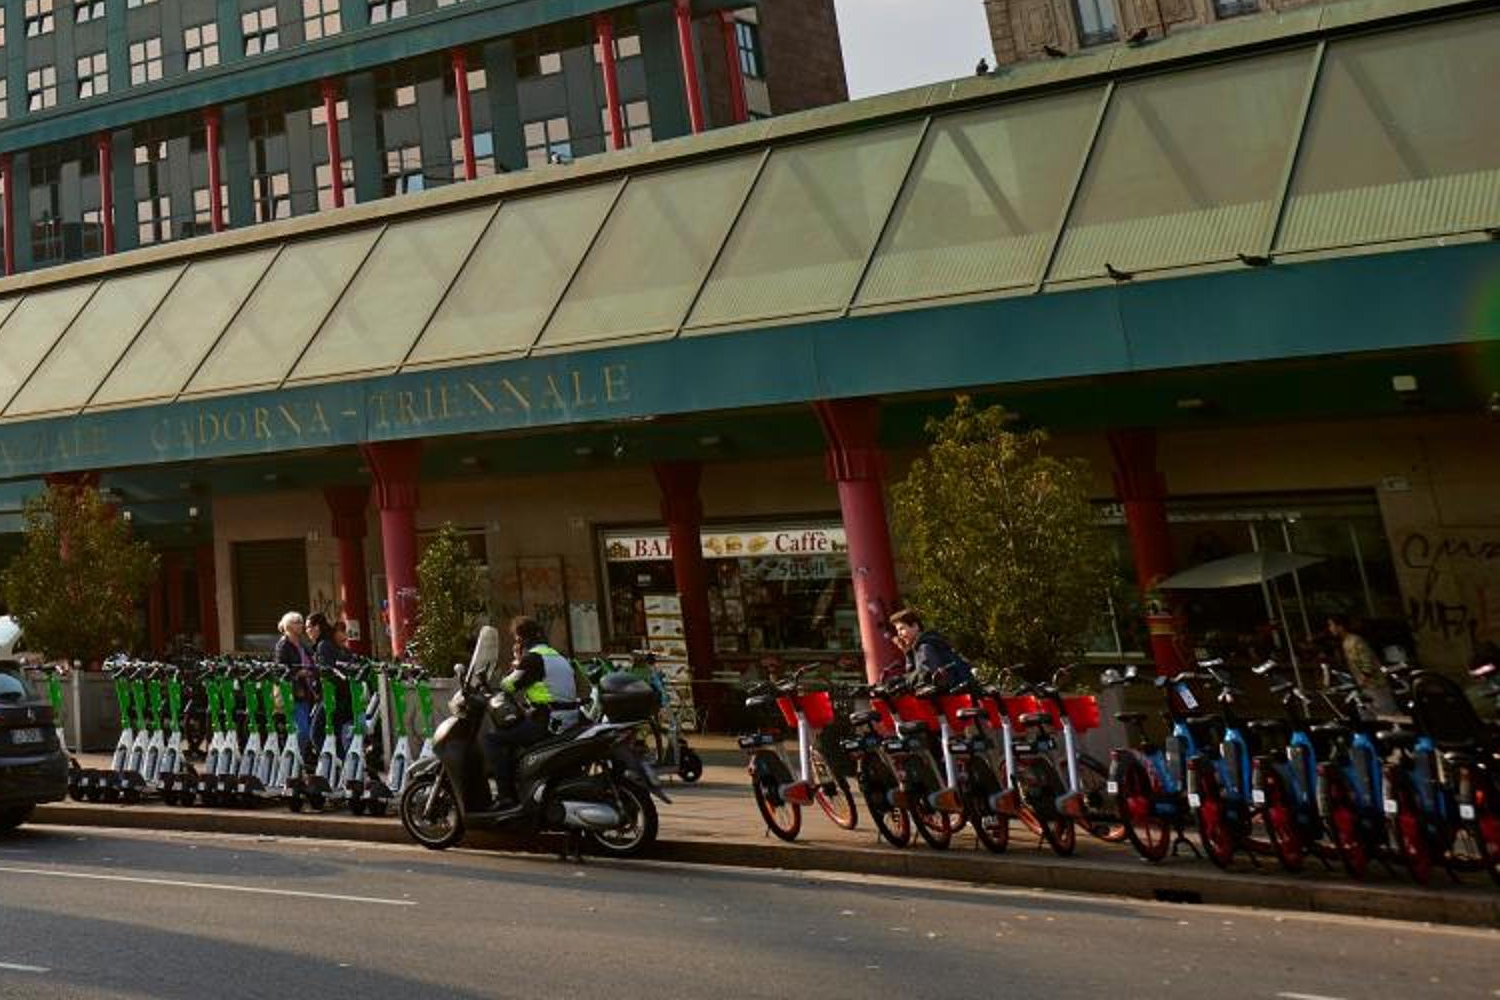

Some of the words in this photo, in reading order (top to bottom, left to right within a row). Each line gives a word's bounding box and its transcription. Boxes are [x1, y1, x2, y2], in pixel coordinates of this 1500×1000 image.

[151, 399, 331, 450] CADORNA
[371, 364, 630, 428] TRIENNALE
[775, 530, 828, 552] Caffè
